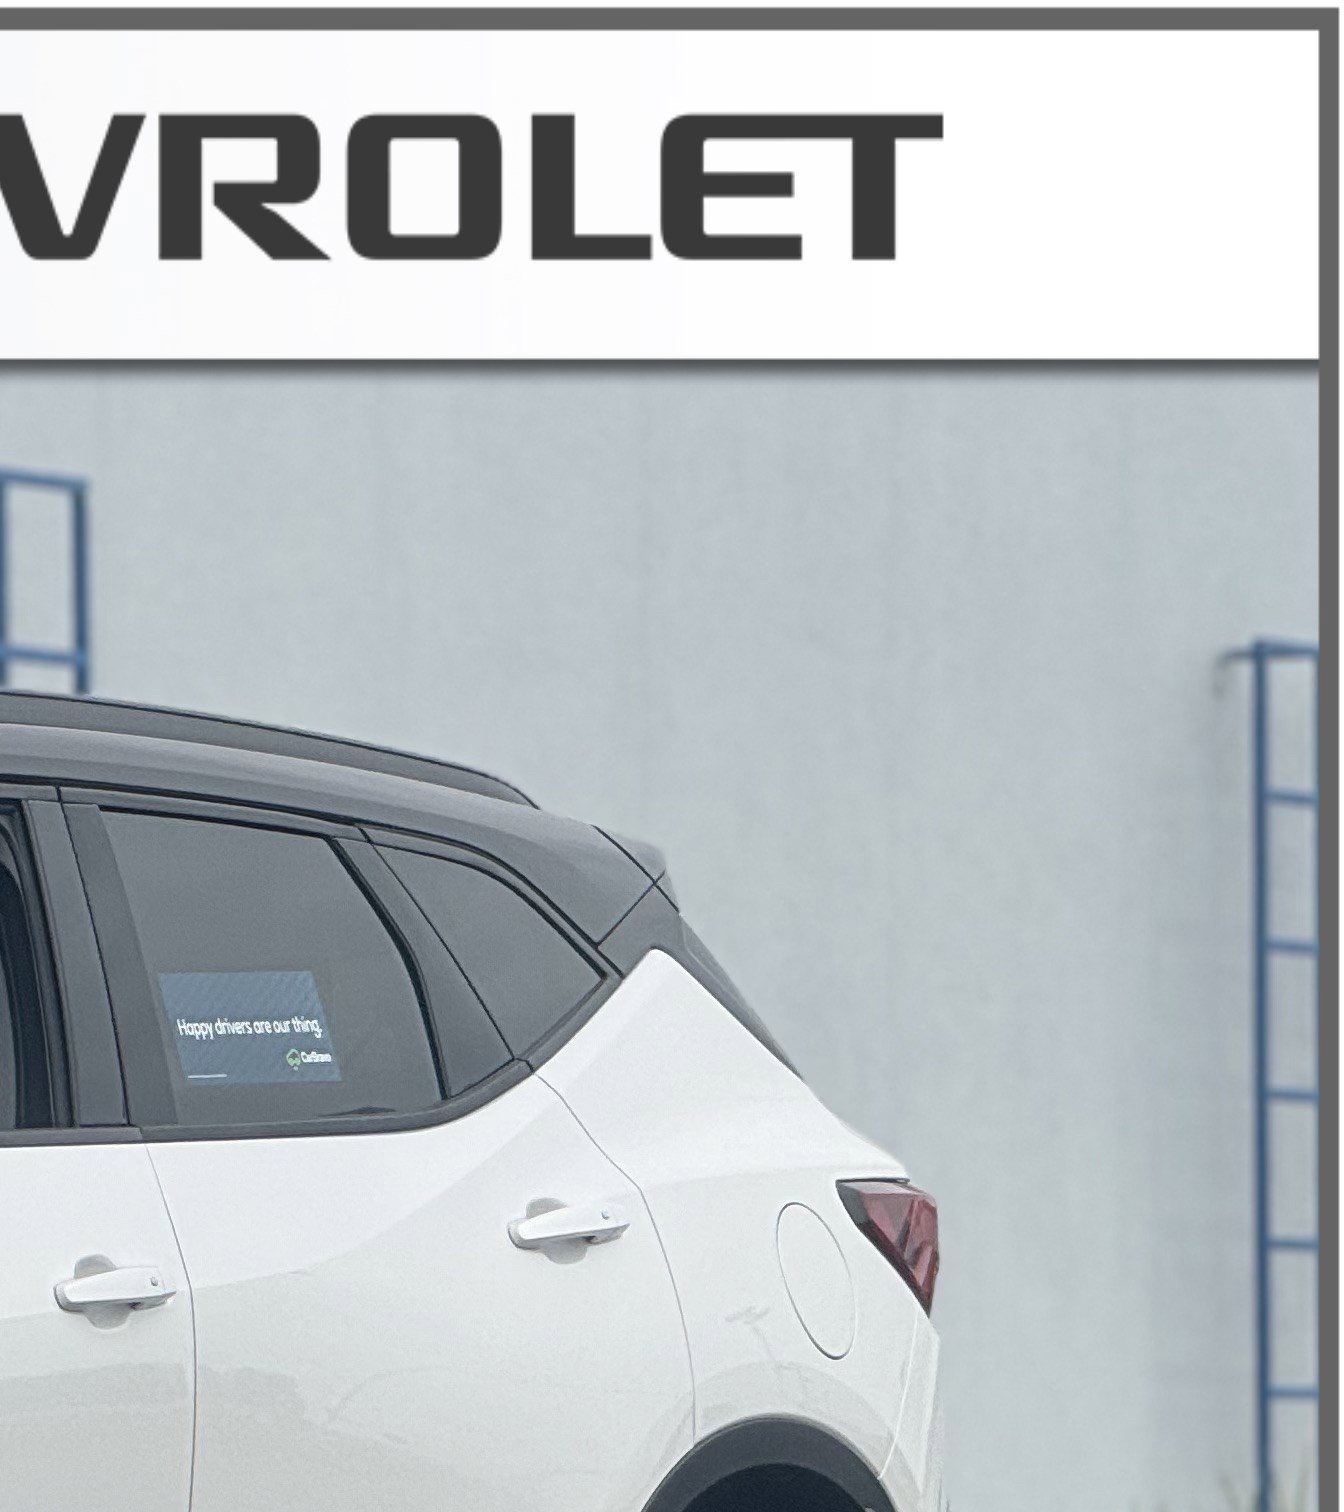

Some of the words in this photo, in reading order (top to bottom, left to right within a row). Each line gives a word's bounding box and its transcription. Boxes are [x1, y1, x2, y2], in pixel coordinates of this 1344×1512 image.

[176, 1018, 214, 1039] Happy
[215, 1017, 252, 1035] drivers
[253, 1019, 272, 1034] are
[273, 1019, 291, 1033] our
